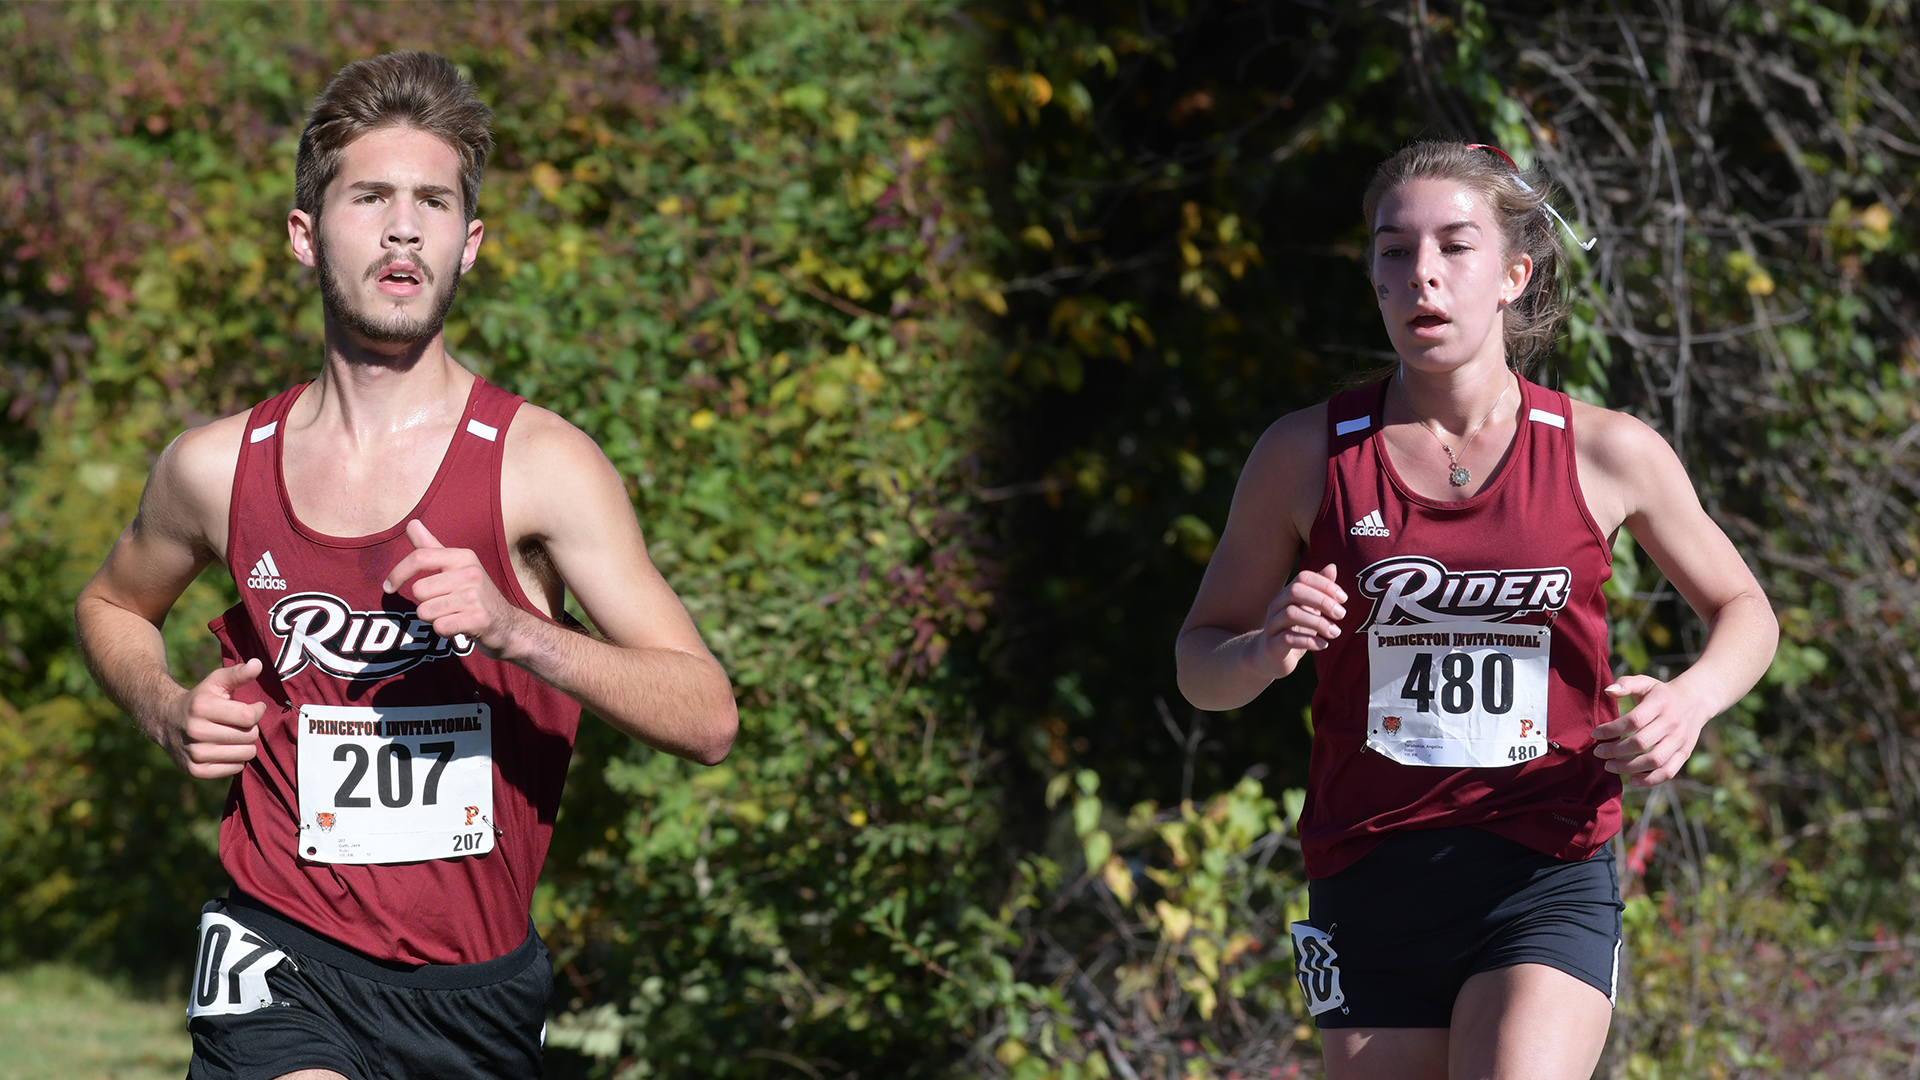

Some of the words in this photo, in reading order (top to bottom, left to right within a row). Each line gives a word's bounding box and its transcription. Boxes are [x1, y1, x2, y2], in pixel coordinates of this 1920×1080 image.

[1350, 525, 1391, 538] adidas
[247, 576, 287, 591] adidas
[1378, 634, 1450, 648] PRINCETON
[1452, 633, 1541, 648] INVITATIONAL
[1400, 652, 1514, 715] 480
[308, 719, 382, 736] PRINCETON
[385, 716, 482, 737] INVITATIONAL
[1507, 746, 1538, 762] 480
[332, 740, 456, 809] 207
[452, 832, 484, 852] 207
